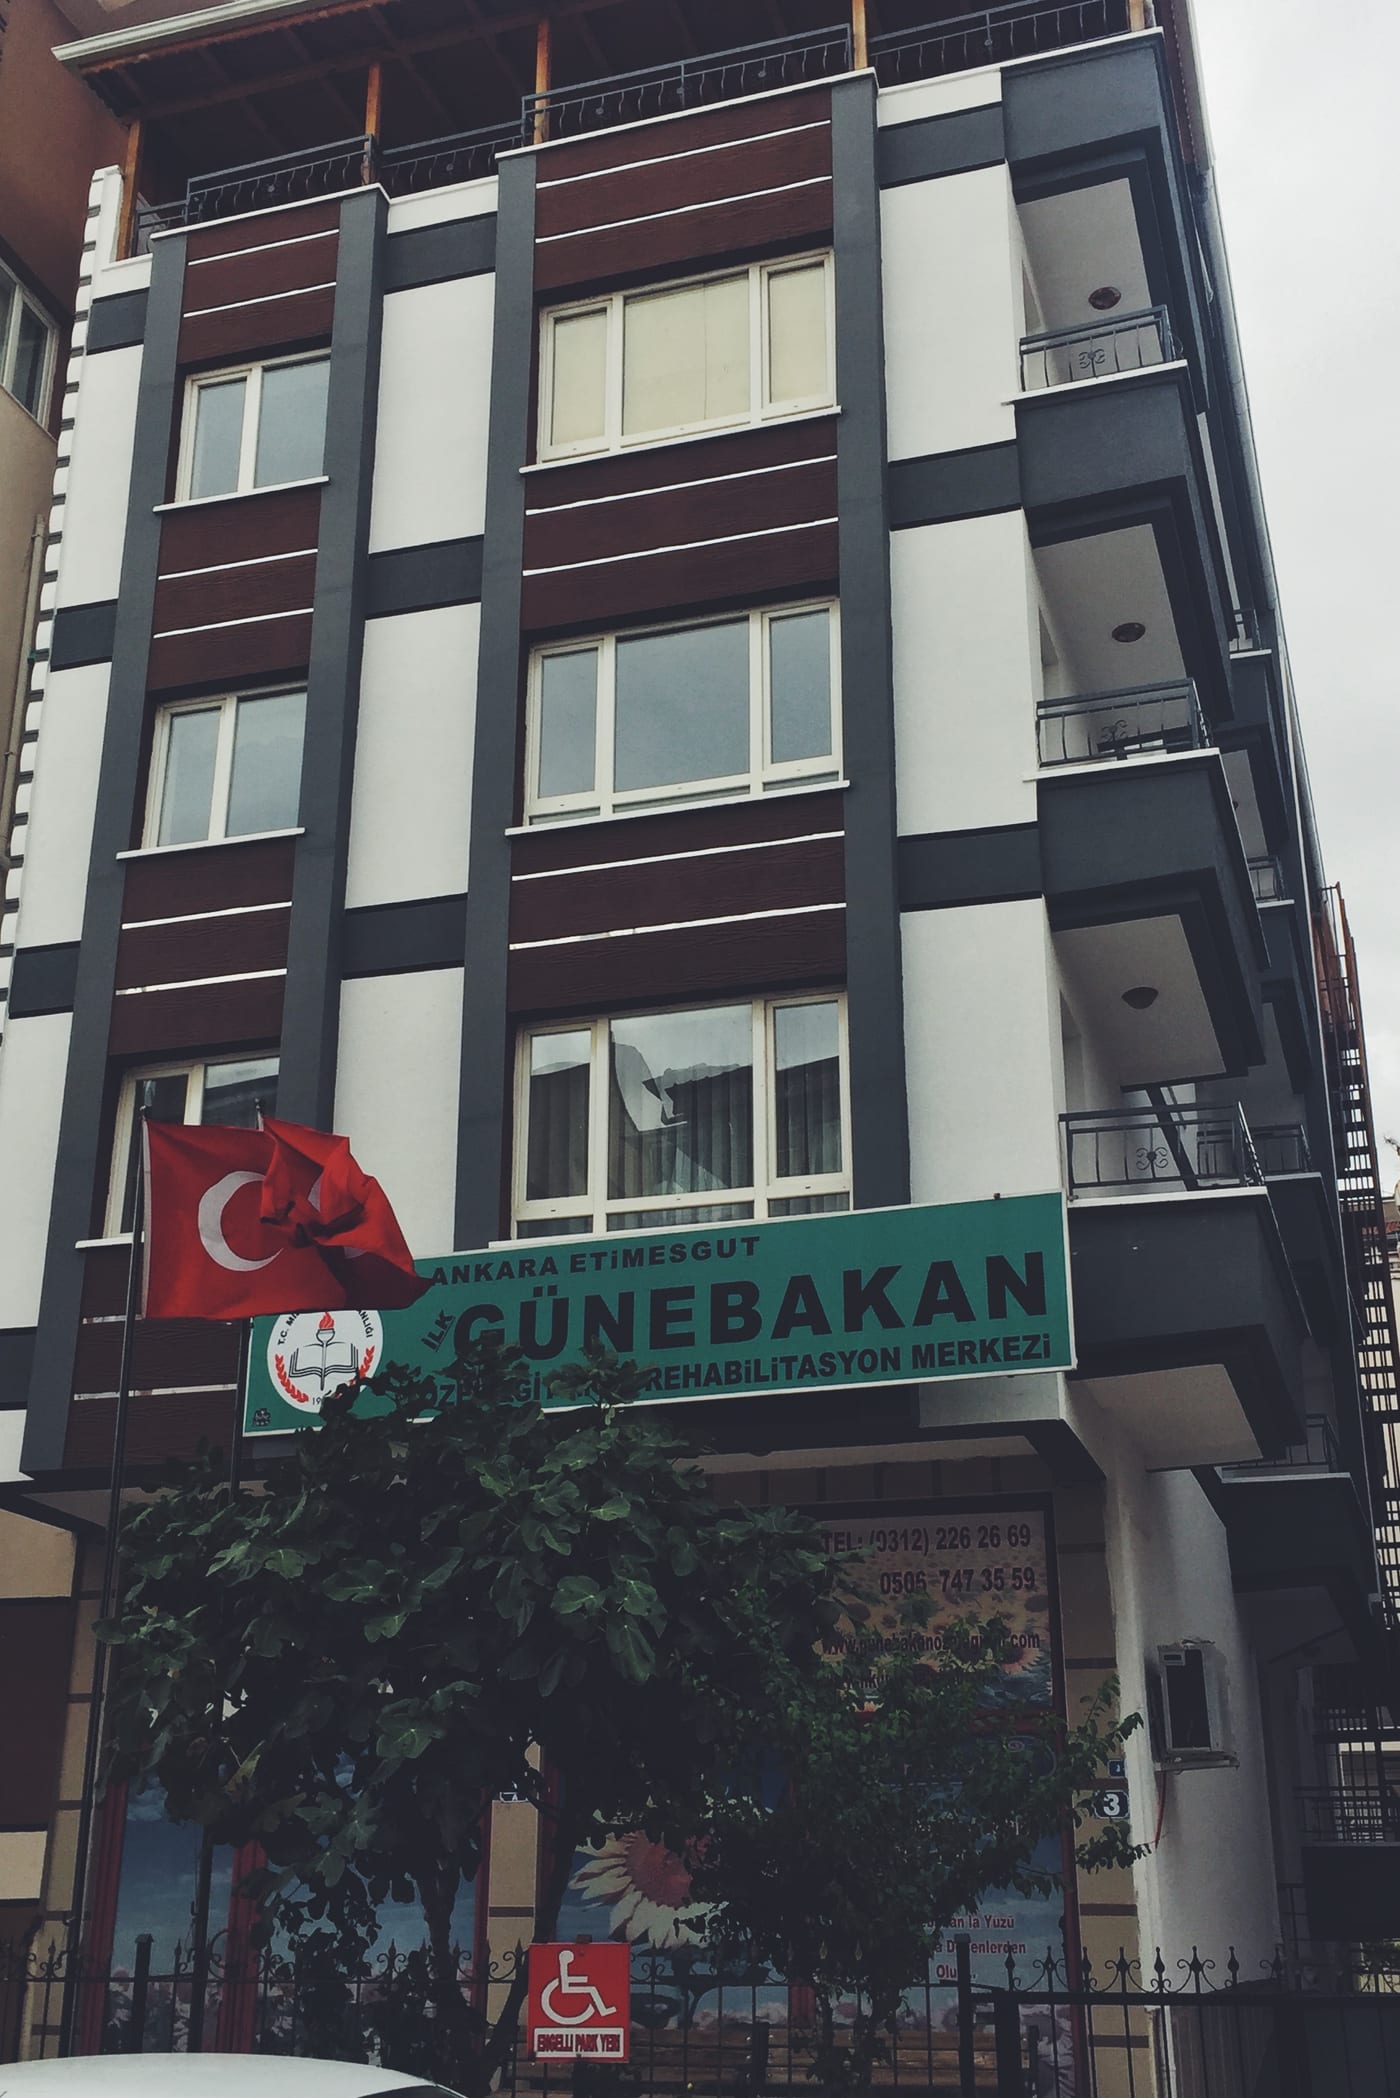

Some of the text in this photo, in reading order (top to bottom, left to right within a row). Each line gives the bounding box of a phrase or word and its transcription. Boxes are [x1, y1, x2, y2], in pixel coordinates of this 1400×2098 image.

[430, 1255, 559, 1287] ANKARA
[453, 1251, 1047, 1361] GÜNEBAKAN
[935, 1526, 971, 1550] 226
[977, 1525, 1001, 1548] 26
[1007, 1523, 1031, 1547] 69
[938, 1568, 975, 1592] 747
[981, 1567, 1005, 1591] 35
[1011, 1566, 1036, 1591] 59
[1103, 1793, 1121, 1816] 3
[575, 2033, 598, 2052] PARK
